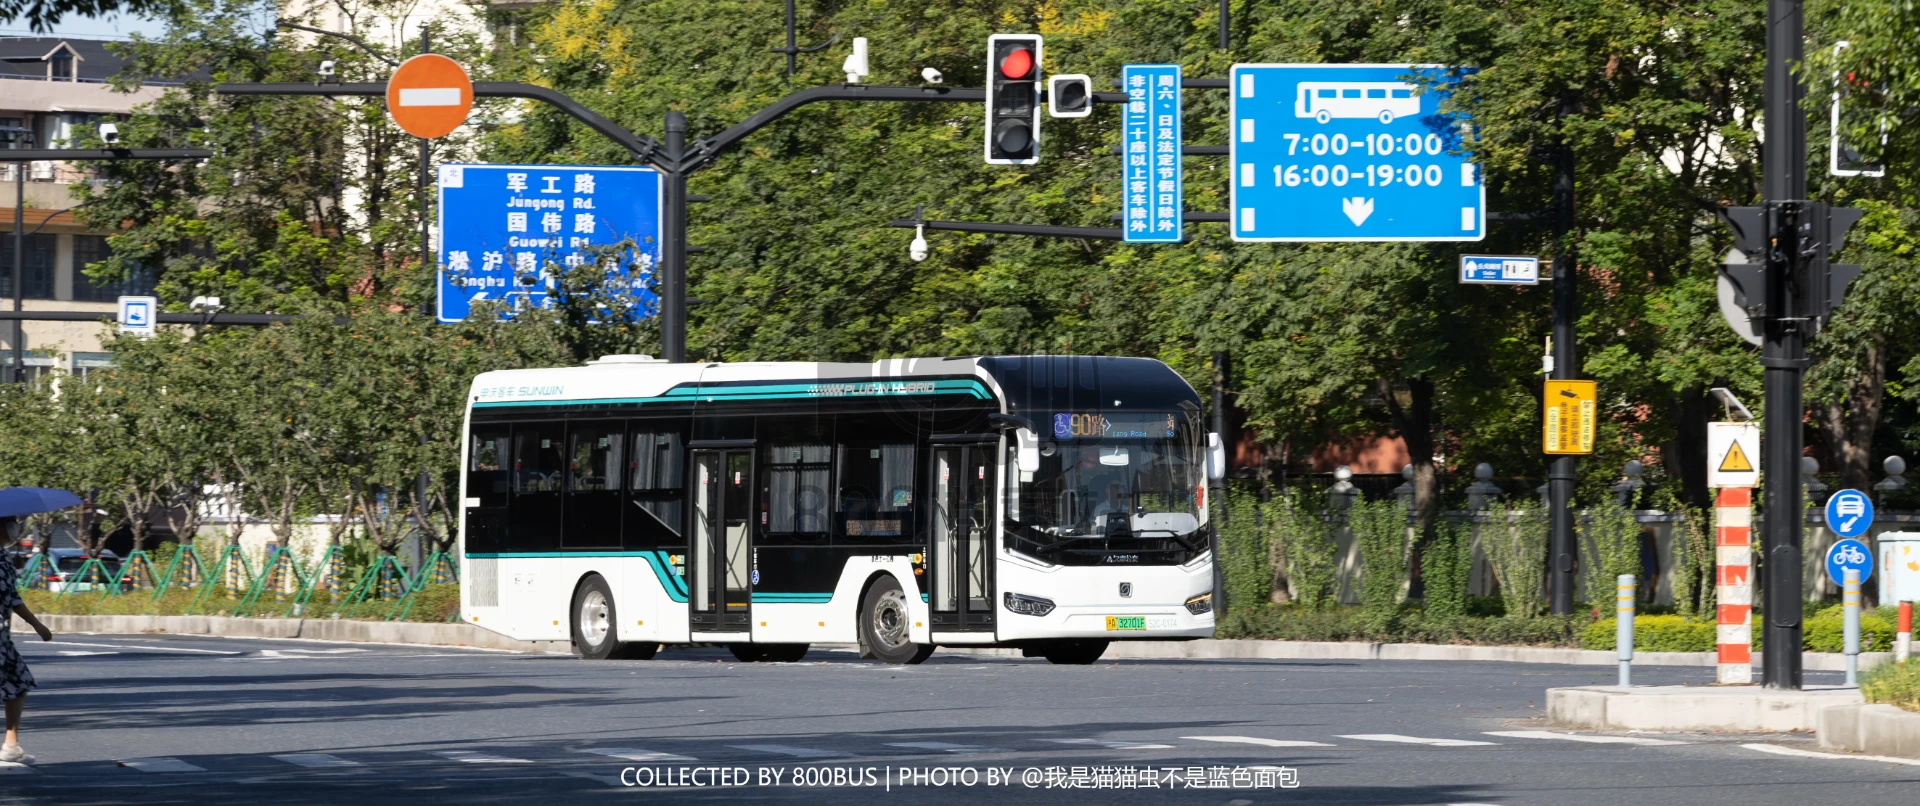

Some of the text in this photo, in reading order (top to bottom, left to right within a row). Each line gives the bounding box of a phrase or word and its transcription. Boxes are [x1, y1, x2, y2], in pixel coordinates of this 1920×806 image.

[1128, 75, 1148, 232] 非空载二十座以上客车除外
[1157, 75, 1175, 232] 周六、日及法定节假日除外
[1283, 133, 1442, 156] 7:00-10:00
[506, 173, 596, 194] 军工路
[1273, 164, 1443, 187] 16:00-19:00
[506, 197, 565, 211] Jungong
[507, 212, 596, 233] 国伟路
[448, 250, 538, 273] 淞沪路
[518, 386, 564, 396] SUNWIN
[892, 382, 935, 394] HYBRID
[1070, 413, 1107, 436] 90路
